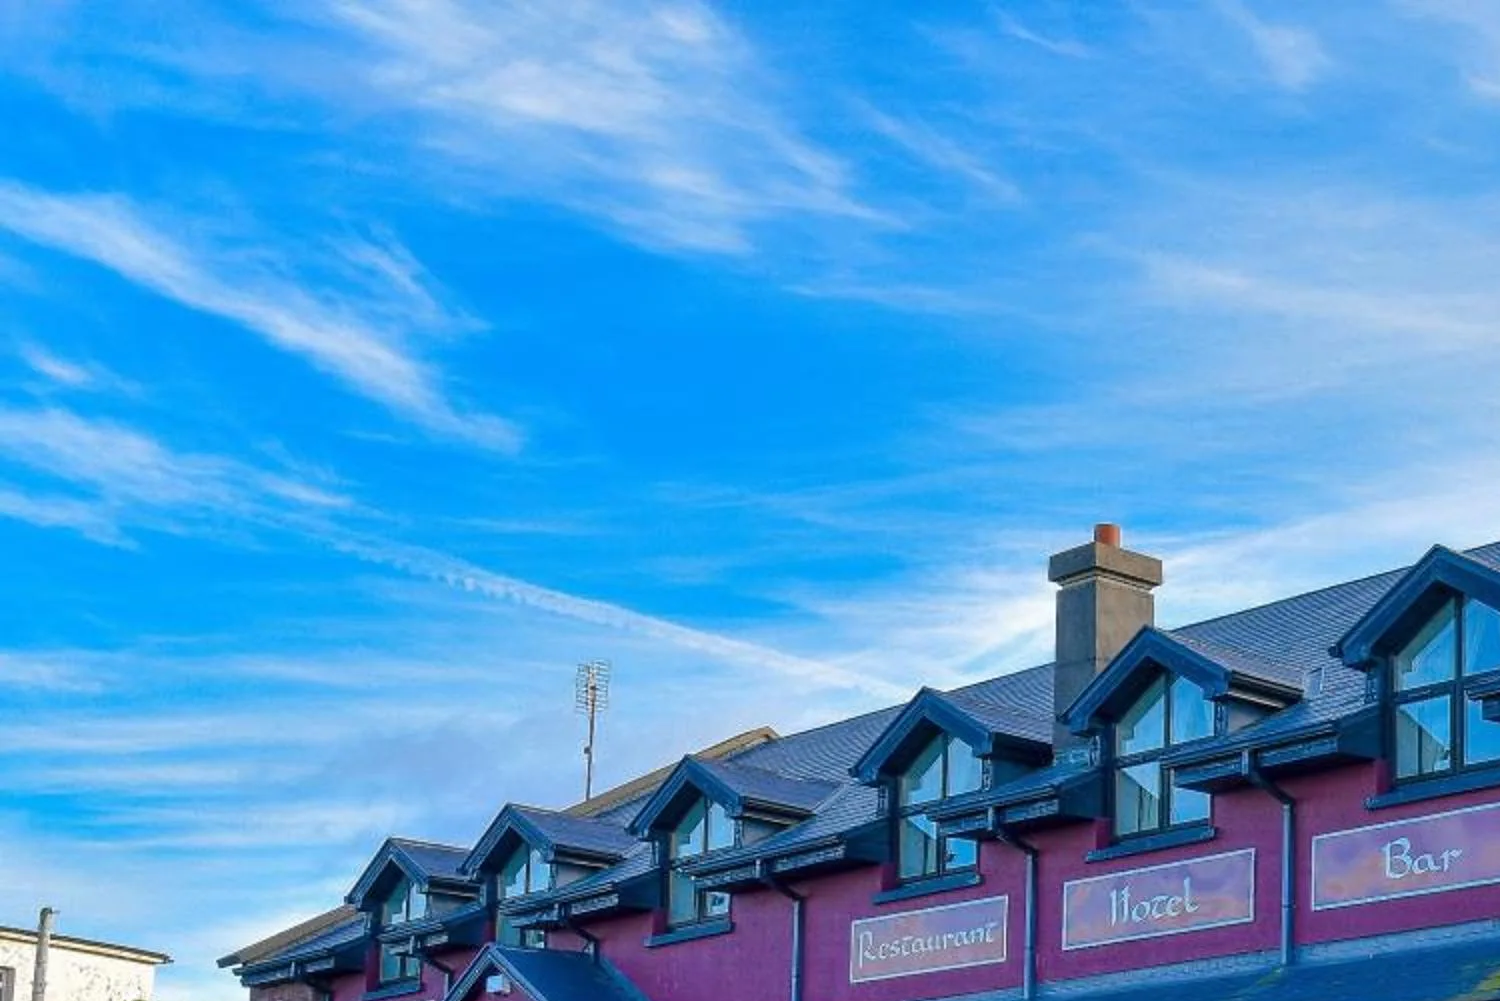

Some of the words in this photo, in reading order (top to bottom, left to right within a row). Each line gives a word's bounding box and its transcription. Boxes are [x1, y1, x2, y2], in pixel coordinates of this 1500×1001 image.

[1385, 836, 1462, 879] Bar
[1109, 877, 1200, 926] Hotel
[859, 922, 998, 969] Restaurant
